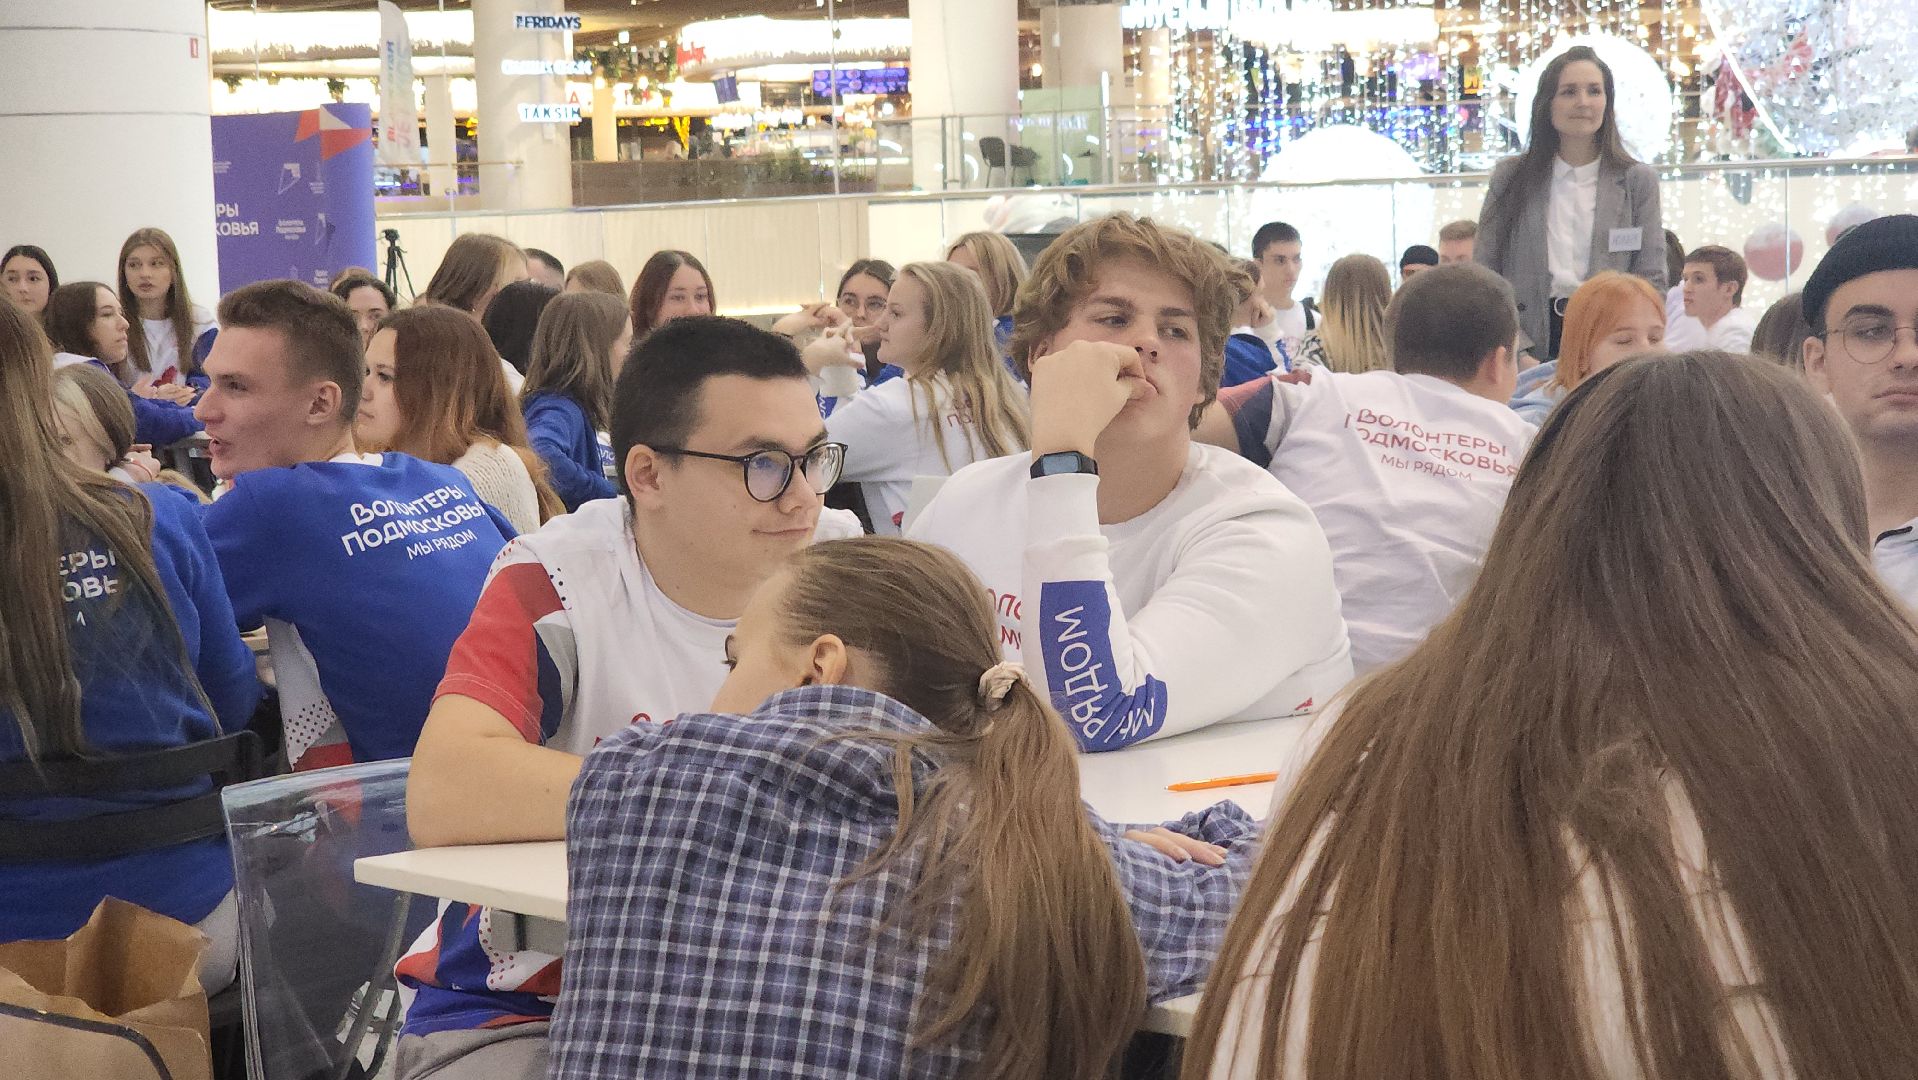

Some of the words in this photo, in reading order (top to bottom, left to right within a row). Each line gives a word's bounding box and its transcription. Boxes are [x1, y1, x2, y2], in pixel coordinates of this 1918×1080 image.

[1357, 408, 1507, 457] ВОЛОНТЕРЫ
[1381, 454, 1409, 470] МЫ
[1413, 460, 1473, 481] РЯДОМ
[350, 485, 467, 526] ВОЛОНТЕРЫ
[406, 541, 435, 561] МЫ
[431, 528, 478, 551] РЯДОМ
[1054, 605, 1114, 739] РЯДОМ
